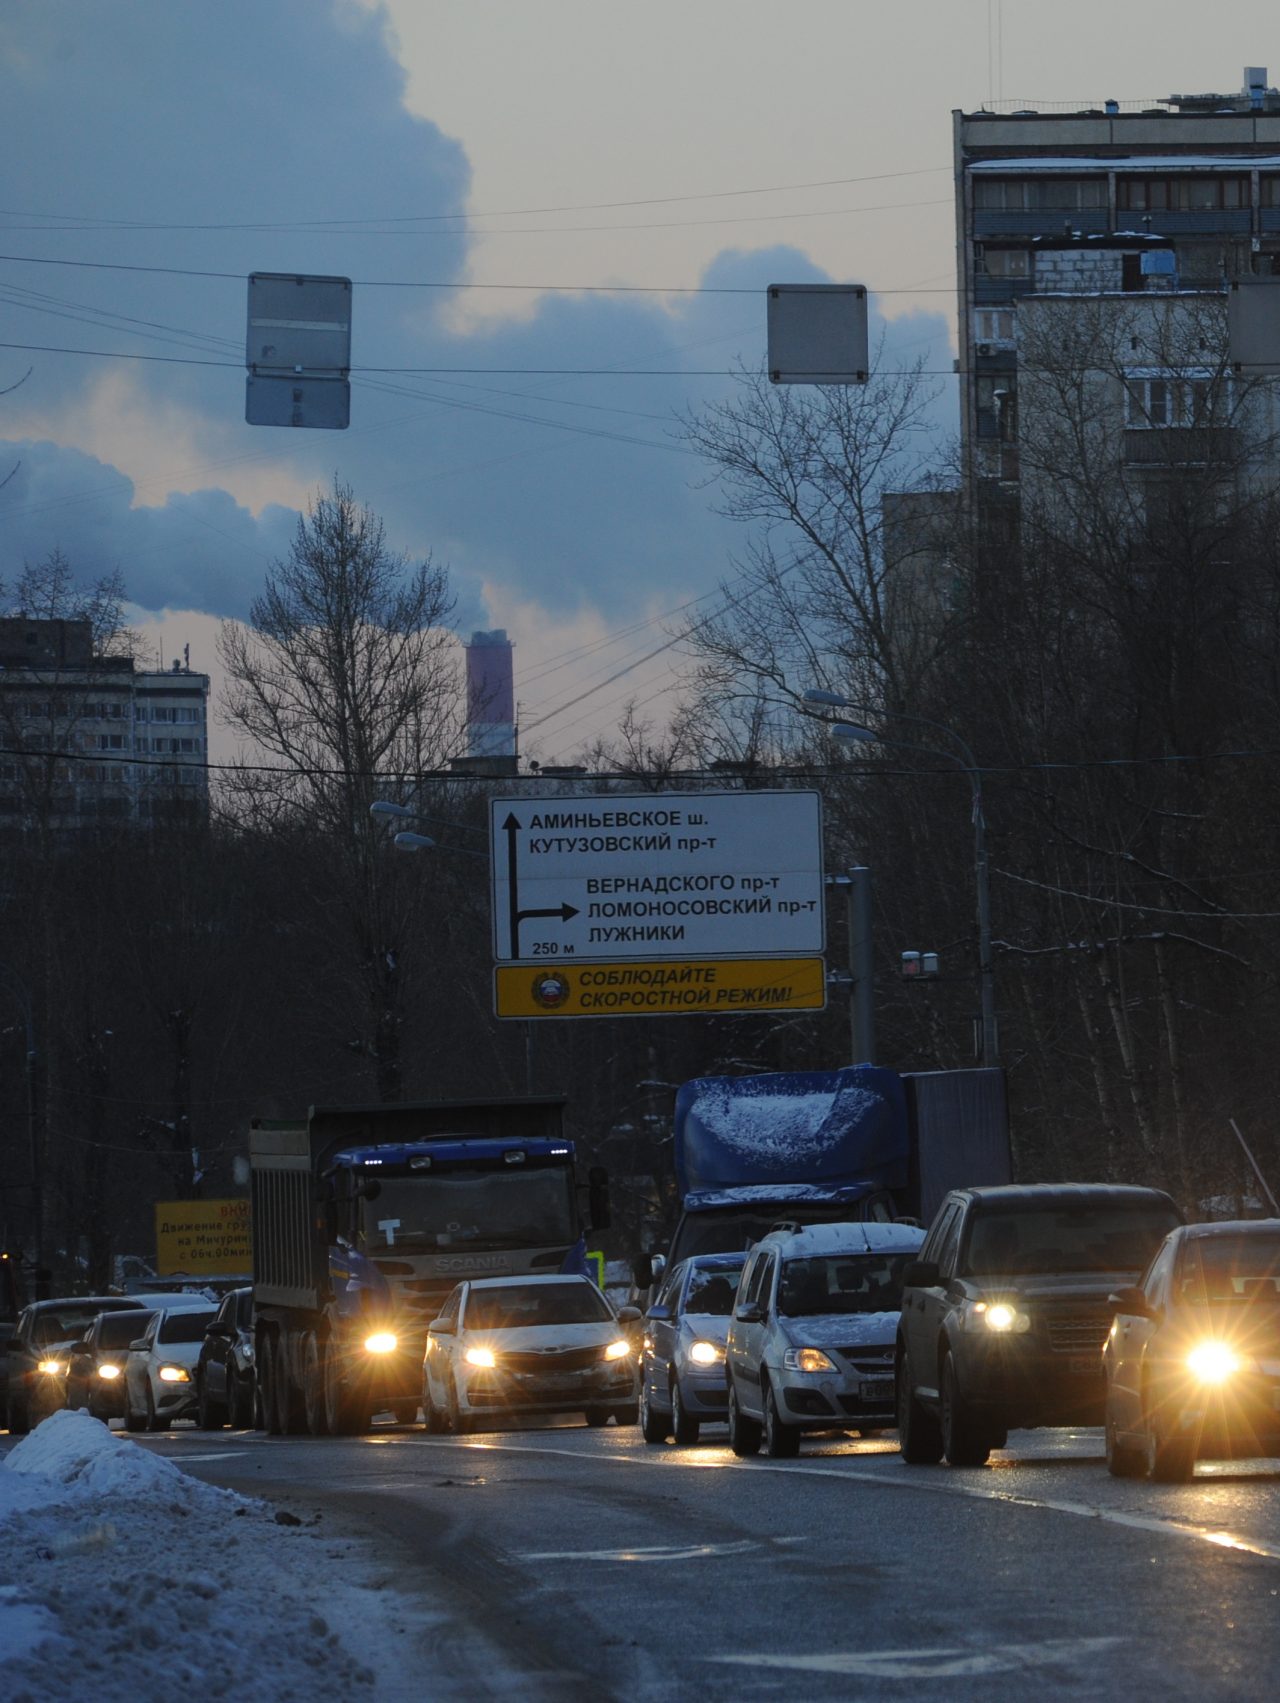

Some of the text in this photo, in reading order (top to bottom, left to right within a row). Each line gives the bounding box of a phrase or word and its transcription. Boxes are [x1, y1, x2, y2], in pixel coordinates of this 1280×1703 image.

[529, 811, 708, 830] АМИНЬЕВСКОЕ ш.
[529, 832, 717, 854] КУТУЗОВСКИЙ пр-т
[586, 874, 780, 895] ВЕРНАДСКОГО пр-т
[588, 896, 817, 918] ЛОМОНОСОВСКИЙ пр-т
[588, 925, 685, 943] ЛУЖНИКИ
[532, 943, 575, 955] 250 м
[579, 967, 716, 986] СОБЛЮДАЙТЕ
[579, 986, 793, 1008] СКОРОСТНОЙ РЕЖИМ!
[161, 1222, 224, 1233] Движение
[177, 1234, 252, 1246] на Мичурин
[434, 1256, 513, 1273] SCANIA
